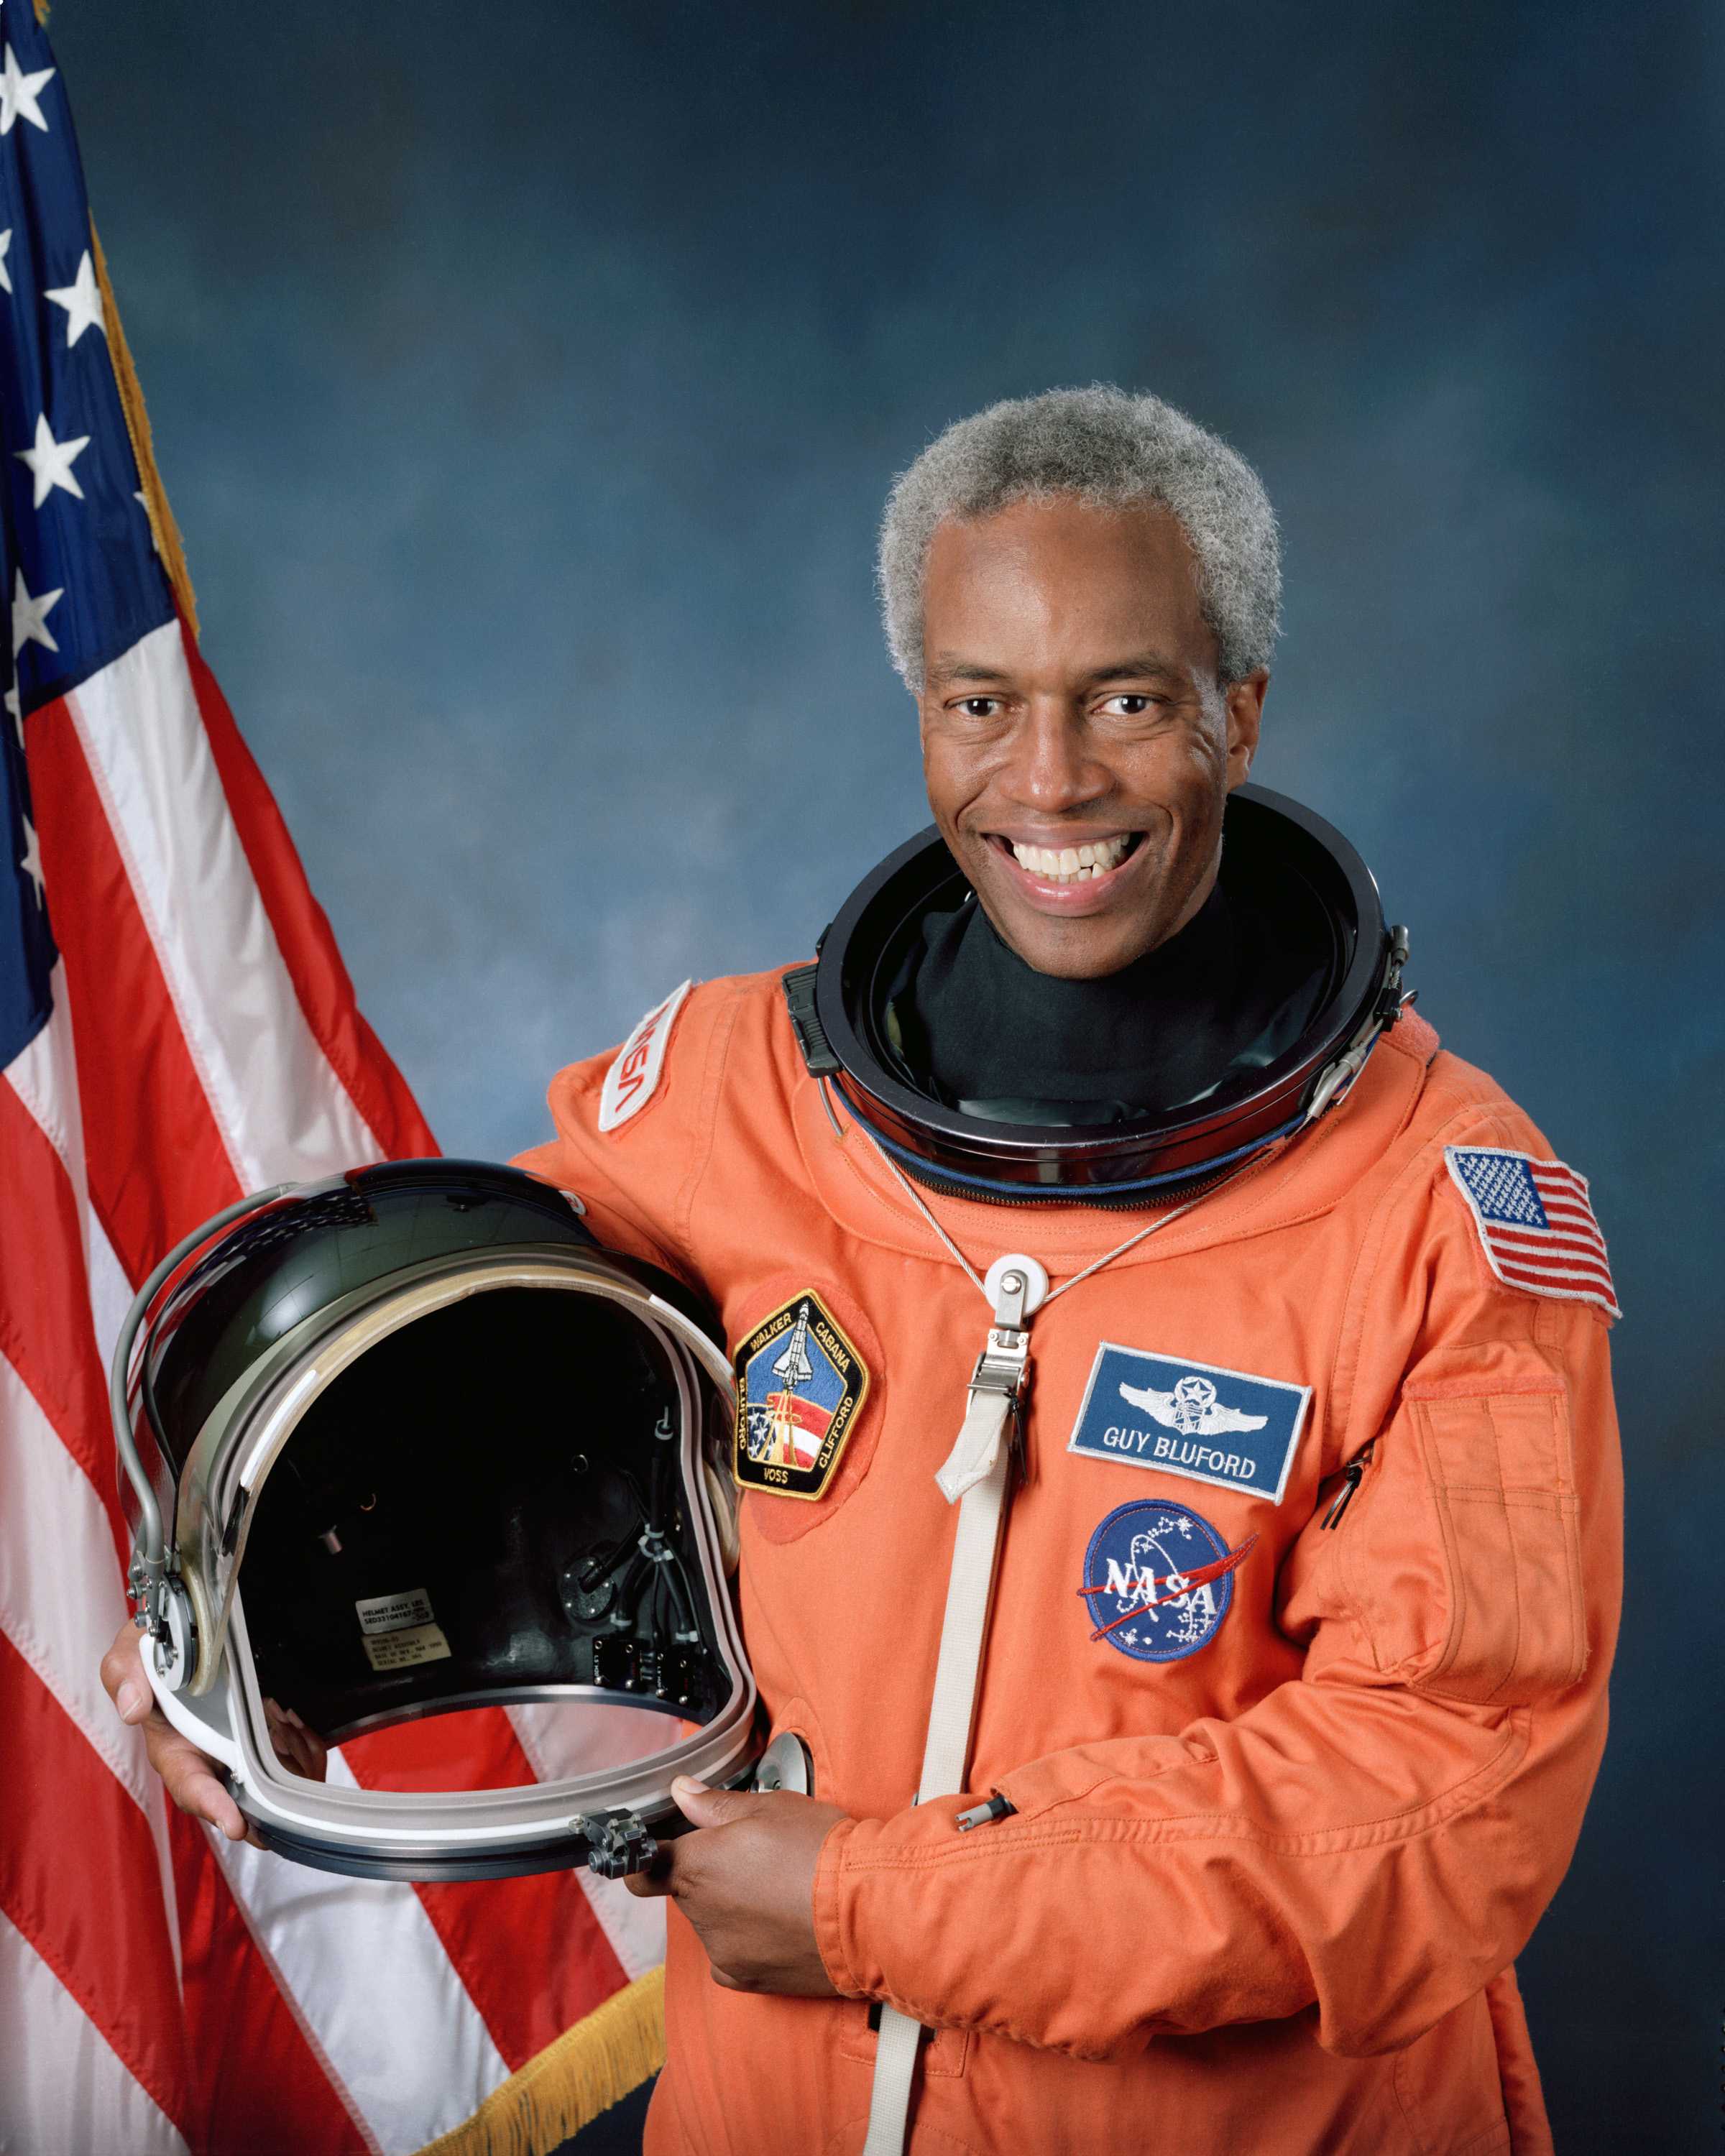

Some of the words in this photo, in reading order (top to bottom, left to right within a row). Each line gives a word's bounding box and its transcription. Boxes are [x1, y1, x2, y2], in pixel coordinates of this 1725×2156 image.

[750, 1312, 792, 1351] WALKER
[815, 1322, 851, 1373] CABANA
[819, 1396, 854, 1469] CLIFFORD
[1103, 1427, 1150, 1452] GUY
[1154, 1437, 1256, 1479] BLUFORD
[763, 1468, 789, 1485] VOSS
[1103, 1557, 1218, 1614] NASA
[362, 1607, 389, 1617] HELMET
